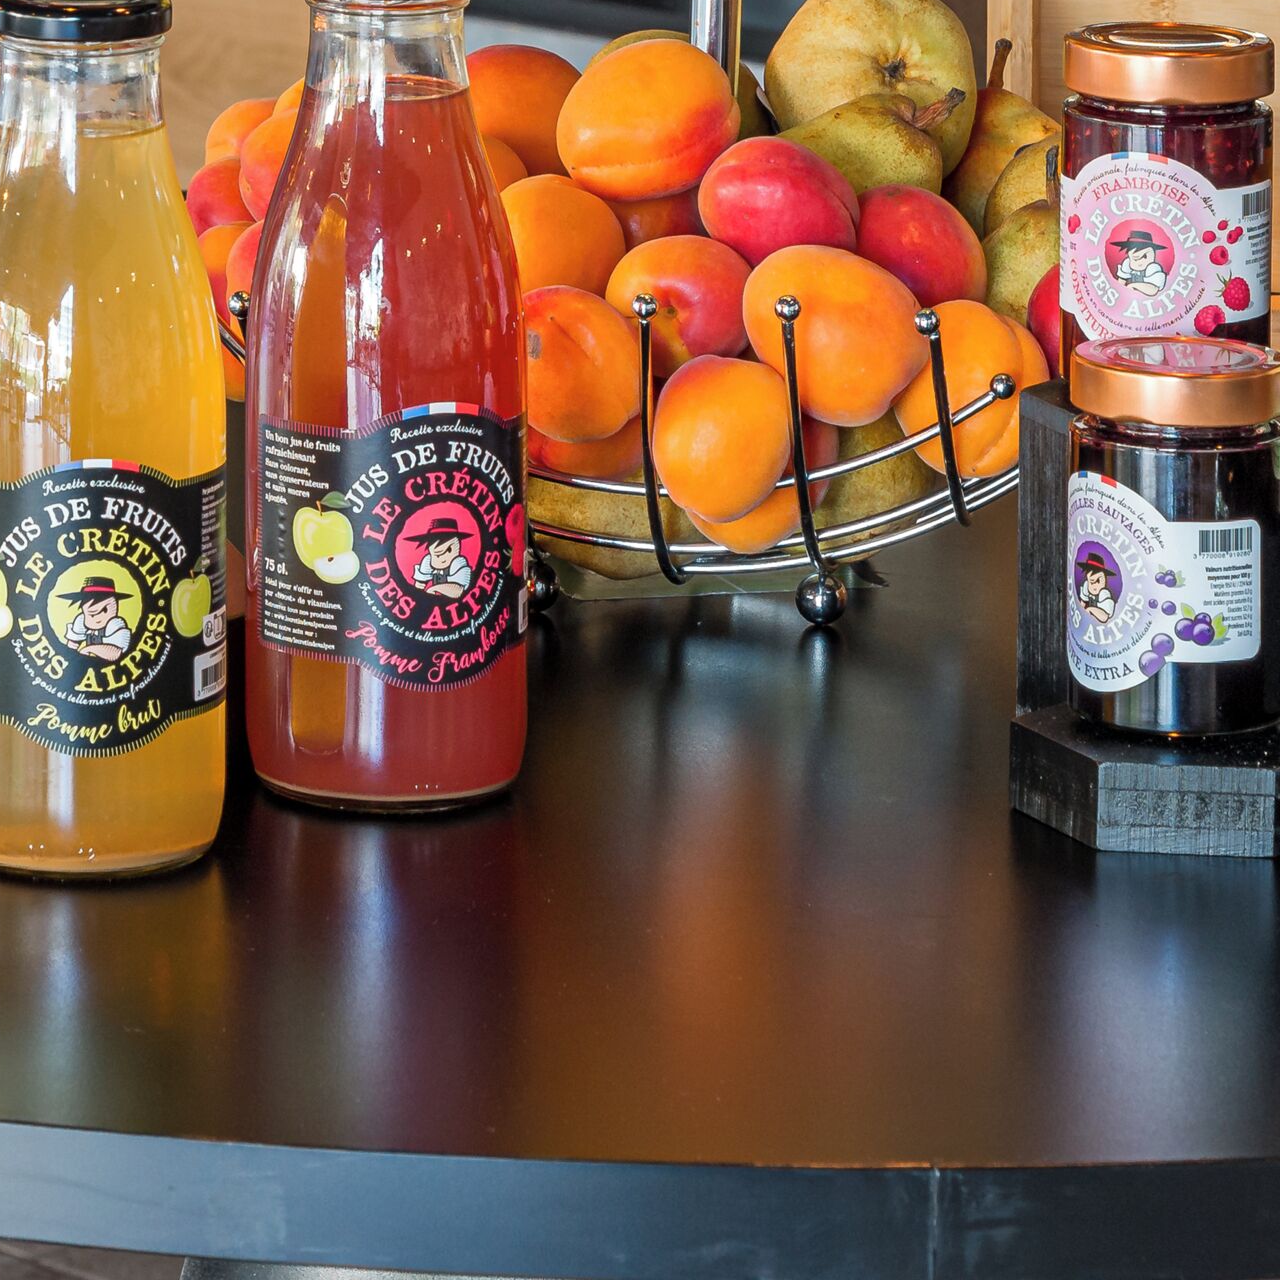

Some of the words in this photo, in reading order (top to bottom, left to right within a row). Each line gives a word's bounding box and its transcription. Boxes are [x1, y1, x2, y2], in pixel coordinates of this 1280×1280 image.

[1092, 176, 1190, 207] FRAMBOISE
[1168, 171, 1189, 189] dans
[1189, 183, 1200, 196] les
[1200, 194, 1217, 217] Alpes
[1085, 208, 1109, 246] LE
[1110, 192, 1201, 250] CRÉTIN
[1086, 256, 1120, 307] DES
[1123, 262, 1198, 319] ALPES
[1145, 313, 1183, 332] tellement
[265, 429, 275, 441] Un
[275, 432, 289, 445] bon
[290, 436, 302, 447] jus
[303, 439, 314, 450] de
[315, 440, 341, 453] fruits
[390, 424, 434, 444] Recette
[436, 419, 484, 436] exclusive
[42, 477, 87, 496] Recette
[90, 474, 145, 494] exclusive
[279, 474, 329, 490] conservateurs
[344, 463, 389, 514] JUS
[391, 442, 437, 474] DE
[446, 441, 515, 505] FRUITS
[44, 497, 91, 528] DE
[100, 496, 187, 566] FRUITS
[363, 497, 402, 545] LE
[404, 467, 503, 532] CRÉTIN
[1097, 501, 1155, 555] SAUVAGES
[1117, 498, 1136, 515] dans
[16, 552, 54, 601] LE
[57, 525, 170, 595] CRÉTIN
[264, 557, 275, 572] 75
[1077, 514, 1148, 578] CRÉTIN
[358, 581, 373, 607] Fort
[372, 606, 383, 619] en
[379, 617, 405, 634] goût
[414, 631, 459, 643] tellement
[365, 557, 416, 619] DES
[421, 551, 500, 629] ALPES
[345, 620, 423, 673] Pomme
[428, 606, 510, 683] Framboise
[1083, 592, 1144, 645] ALPES
[11, 638, 26, 666] Fort
[24, 664, 35, 677] en
[32, 676, 57, 695] goût
[57, 690, 67, 700] et
[67, 693, 117, 706] tellement
[18, 614, 69, 680] DES
[74, 613, 168, 692] ALPES
[1084, 662, 1134, 680] EXTRA
[1097, 642, 1130, 659] tellement
[27, 702, 113, 744] Pomme
[118, 698, 162, 733] brut
